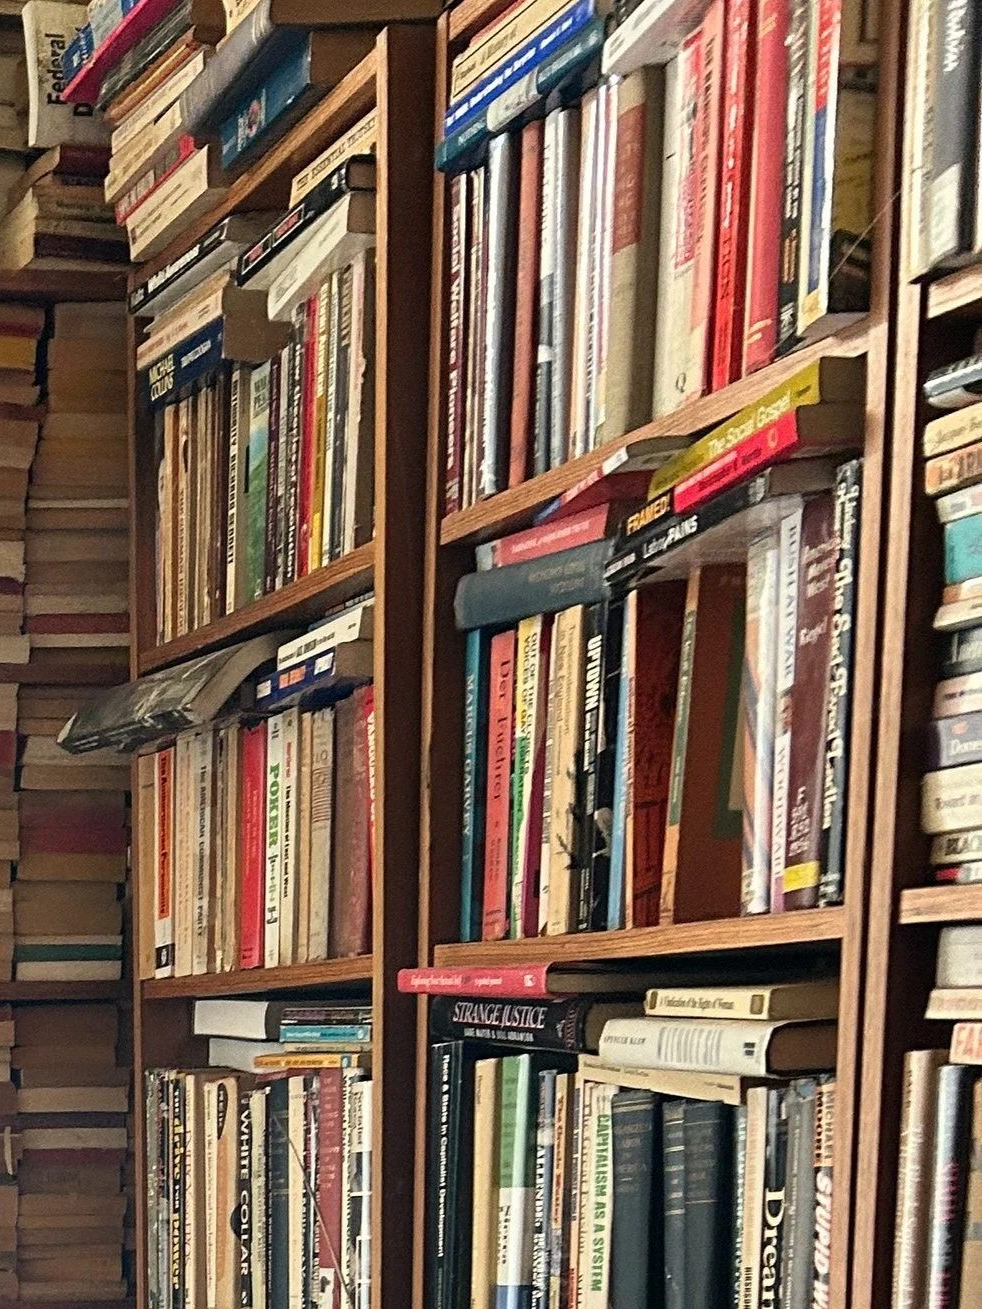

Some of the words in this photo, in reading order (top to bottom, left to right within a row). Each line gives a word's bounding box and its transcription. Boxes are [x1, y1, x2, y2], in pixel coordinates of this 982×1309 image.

[586, 634, 602, 712] UPTOWN
[269, 763, 280, 848] POKER
[452, 1002, 500, 1023] STRANGE
[500, 1004, 547, 1029] JUSTICE
[239, 1110, 252, 1182] WHITE
[594, 1114, 611, 1200] CAPITALISM
[239, 1189, 251, 1278] COLLAR
[594, 1204, 605, 1219] AS
[814, 1172, 833, 1275] STUPID
[590, 1238, 604, 1292] SYSTEM
